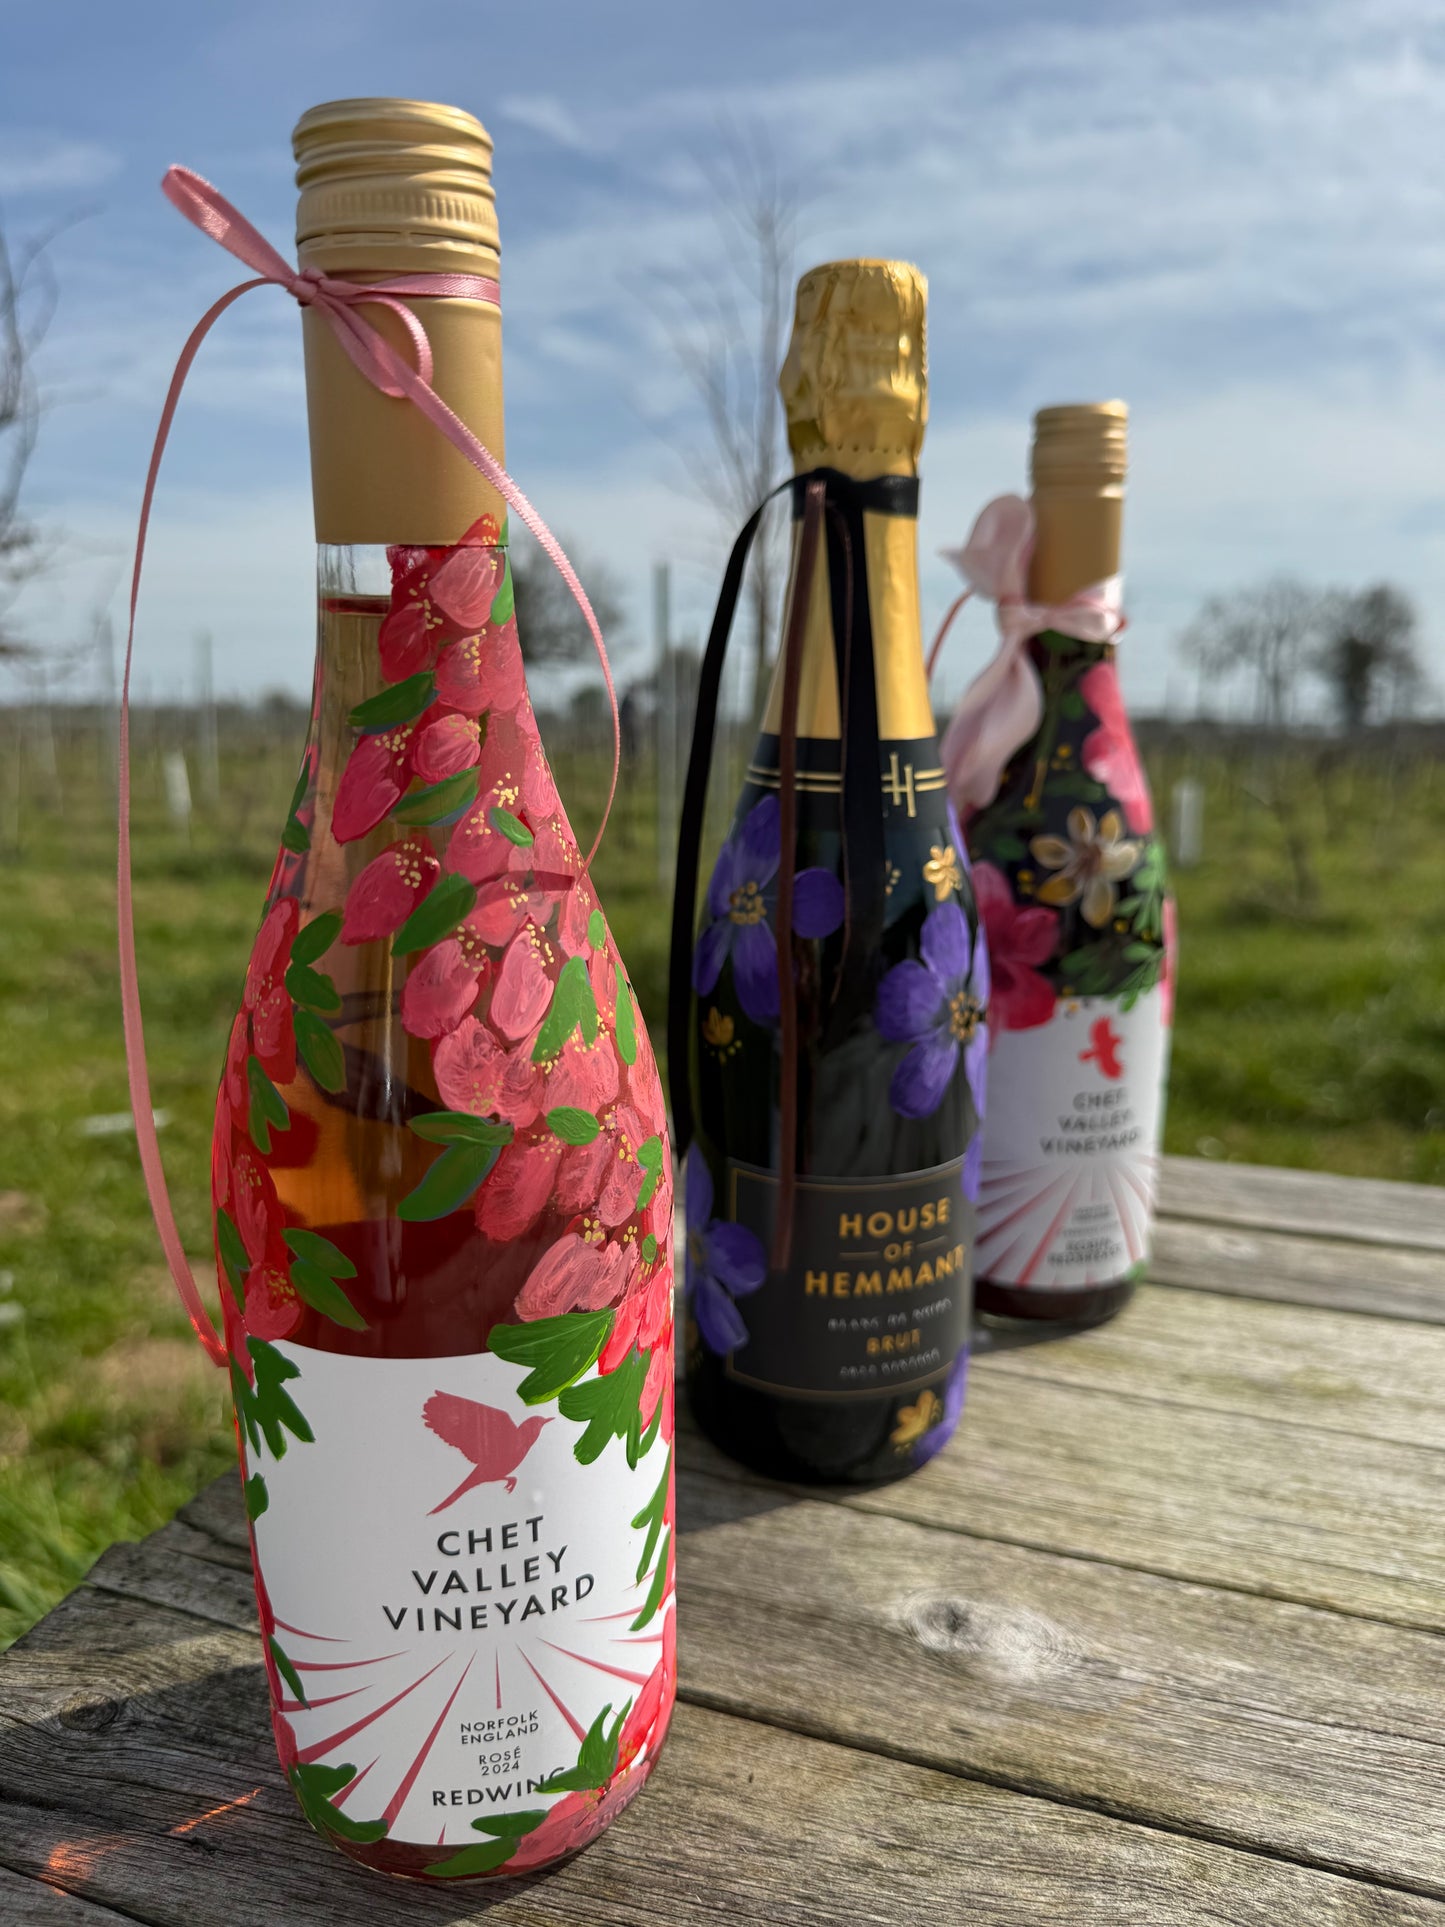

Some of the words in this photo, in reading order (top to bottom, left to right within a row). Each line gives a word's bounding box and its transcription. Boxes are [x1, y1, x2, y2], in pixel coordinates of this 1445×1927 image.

[1057, 1109, 1133, 1134] VALLEY
[838, 1197, 950, 1239] HOUSE
[883, 1241, 914, 1263] OF
[804, 1244, 967, 1297] HEMMANT
[865, 1328, 922, 1355] BRUT
[437, 1515, 544, 1556] CHET
[411, 1545, 568, 1595] VALLEY
[382, 1573, 595, 1631] VINEYARD
[460, 1710, 539, 1733] NORFOLK
[461, 1723, 539, 1745] ENGLAND
[479, 1746, 521, 1765] ROSÉ
[481, 1761, 520, 1776] 2024
